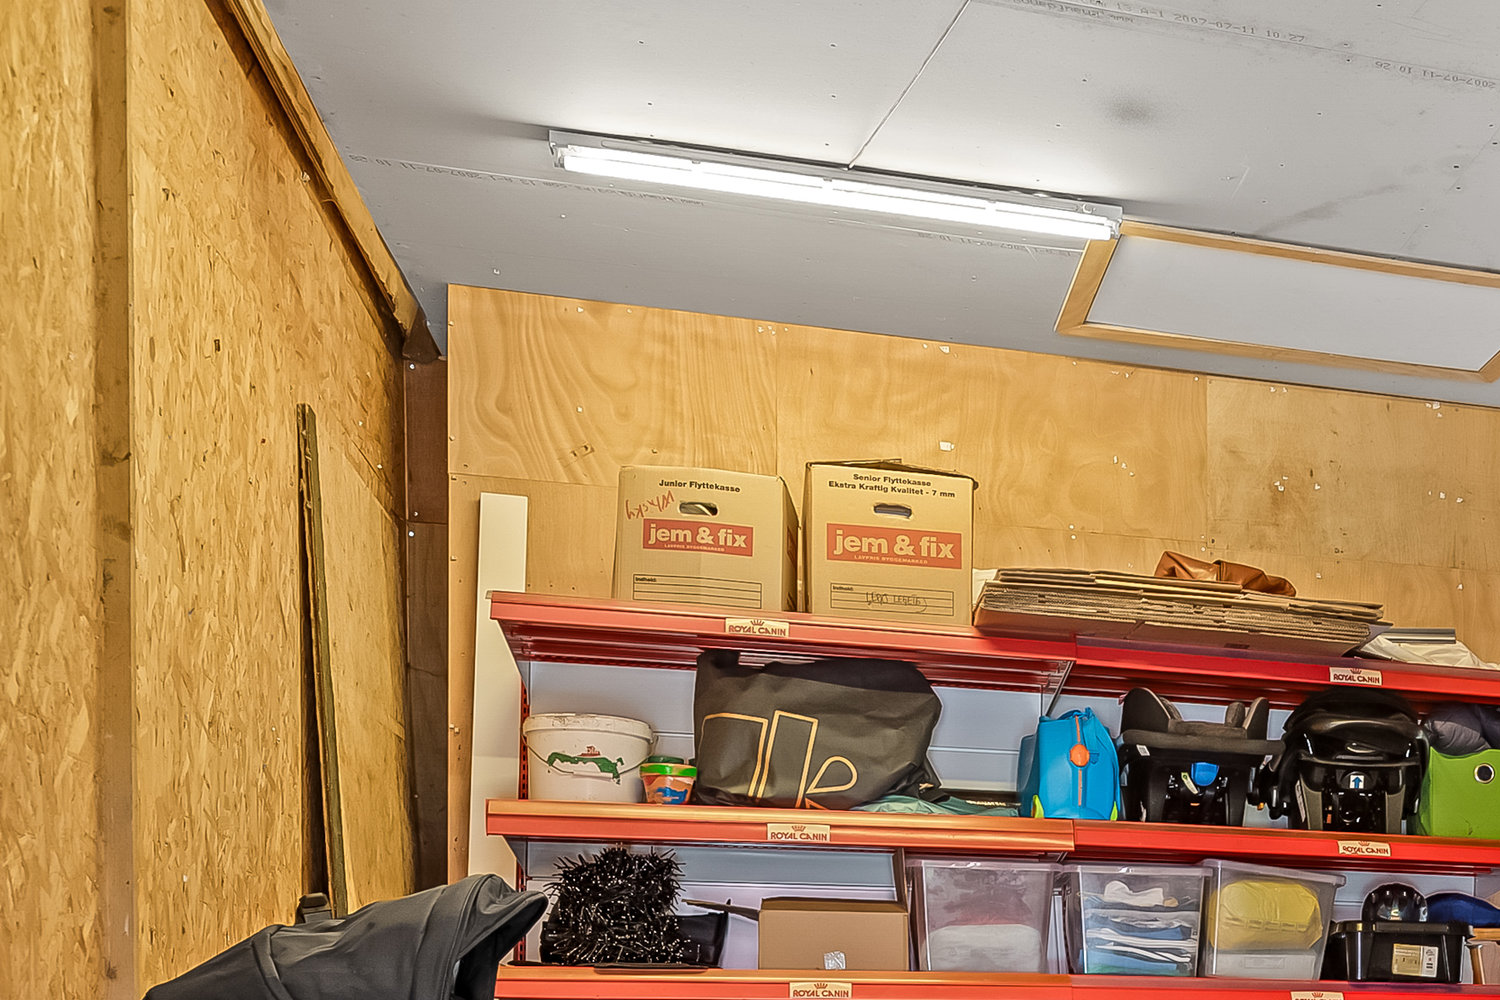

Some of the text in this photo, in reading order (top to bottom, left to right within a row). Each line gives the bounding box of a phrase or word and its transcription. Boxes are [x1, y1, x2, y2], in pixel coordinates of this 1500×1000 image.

[853, 473, 931, 487] Senior Flyttekasse
[659, 480, 741, 493] Junior Flyttekasse
[828, 481, 856, 489] Ekstra
[858, 483, 888, 493] Kraftig
[890, 486, 924, 496] Kvalitet
[648, 523, 747, 548] jem & fix
[833, 529, 955, 559] jem & fix
[728, 625, 786, 637] ROYAL CANIN
[1333, 673, 1380, 684] ROYAL CANIN
[770, 832, 828, 841] ROYAL CANIN
[1342, 845, 1389, 855] ROYAL CANIN
[821, 990, 849, 998] CANIN
